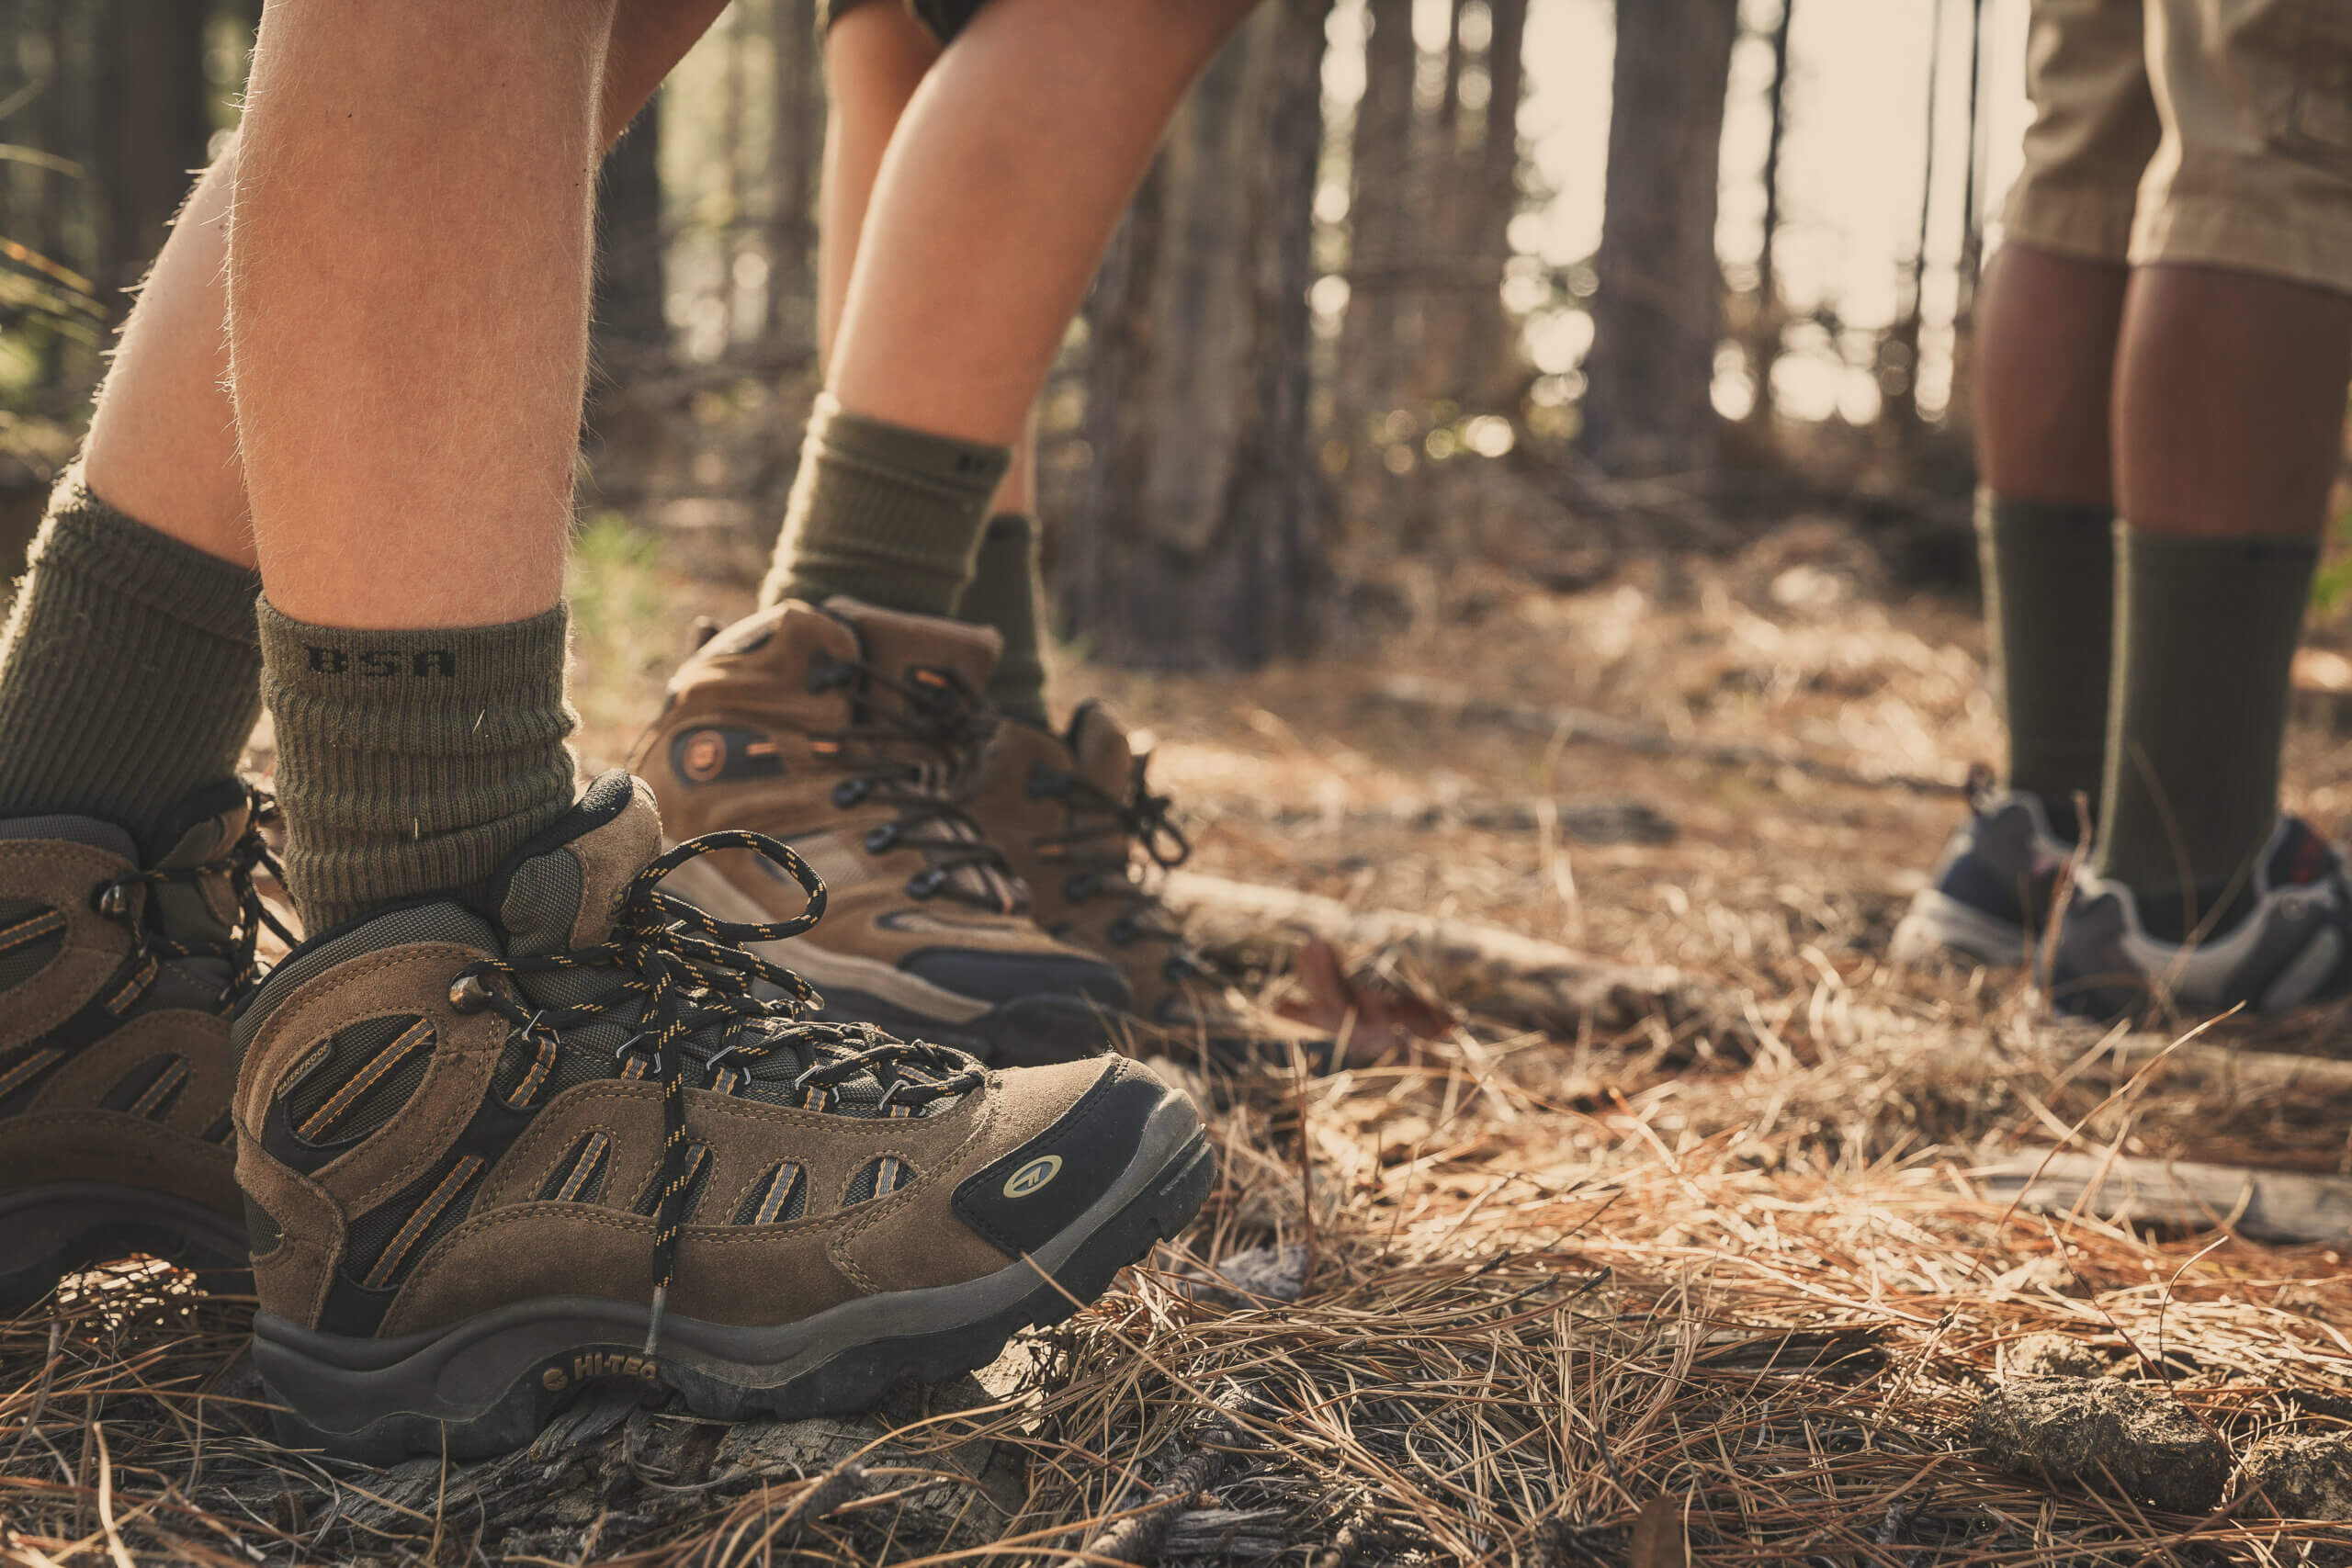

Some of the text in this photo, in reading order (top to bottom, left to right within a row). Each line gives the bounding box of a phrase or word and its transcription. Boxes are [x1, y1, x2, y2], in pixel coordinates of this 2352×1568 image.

[308, 646, 456, 676] BSA
[277, 1043, 330, 1094] WATERPROOF
[574, 1352, 657, 1381] HI-TEC
